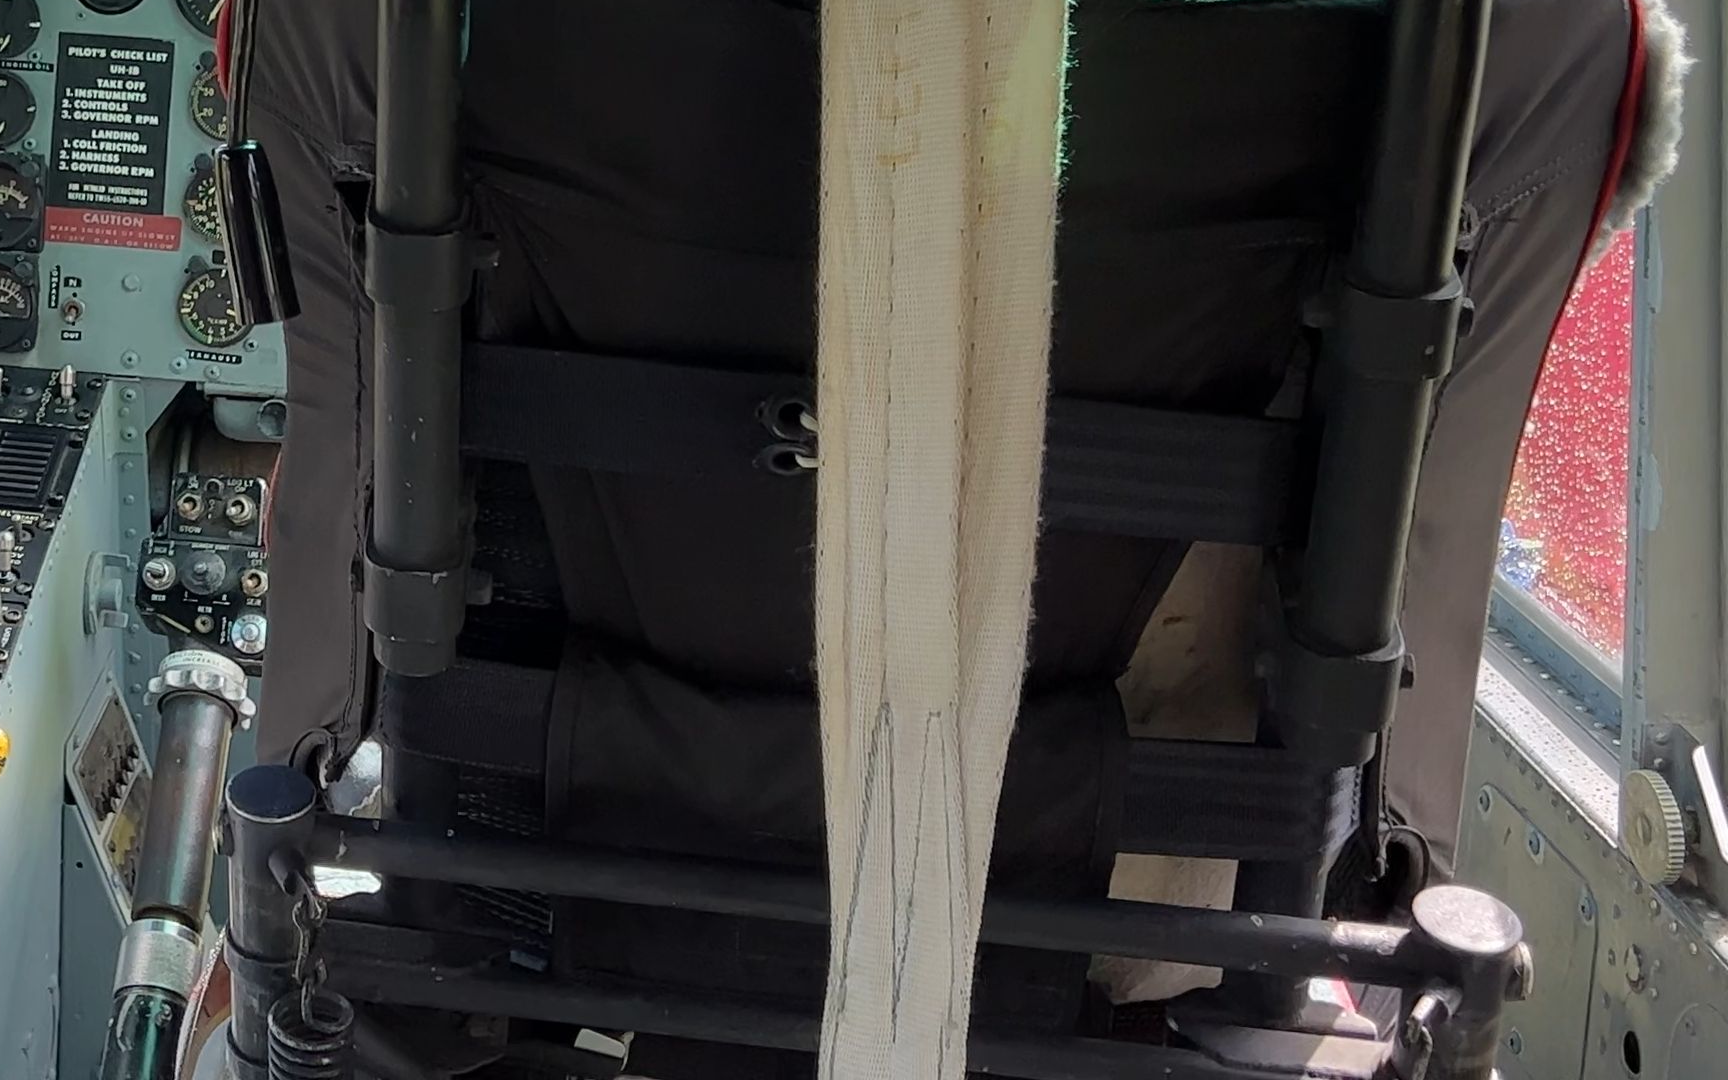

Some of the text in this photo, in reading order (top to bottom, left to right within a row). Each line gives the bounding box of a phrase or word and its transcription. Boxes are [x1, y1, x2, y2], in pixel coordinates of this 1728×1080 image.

[68, 46, 168, 62] PILOT'S CHECK LIST
[96, 78, 146, 91] TAKE OFF
[65, 87, 147, 103] 1. INSTRUMENTS
[61, 98, 128, 112] 2. CONTROLS
[61, 110, 159, 126] 3. GOVERNOR RPM
[91, 128, 140, 142] LANDING
[63, 139, 147, 154] 1. COLL FRICTION
[59, 150, 120, 163] 2. HARNESS
[58, 161, 155, 178] 3. GOVERNOR RPM
[83, 212, 144, 228] CAUTION
[62, 331, 80, 339] OUT
[179, 525, 203, 535] STOW
